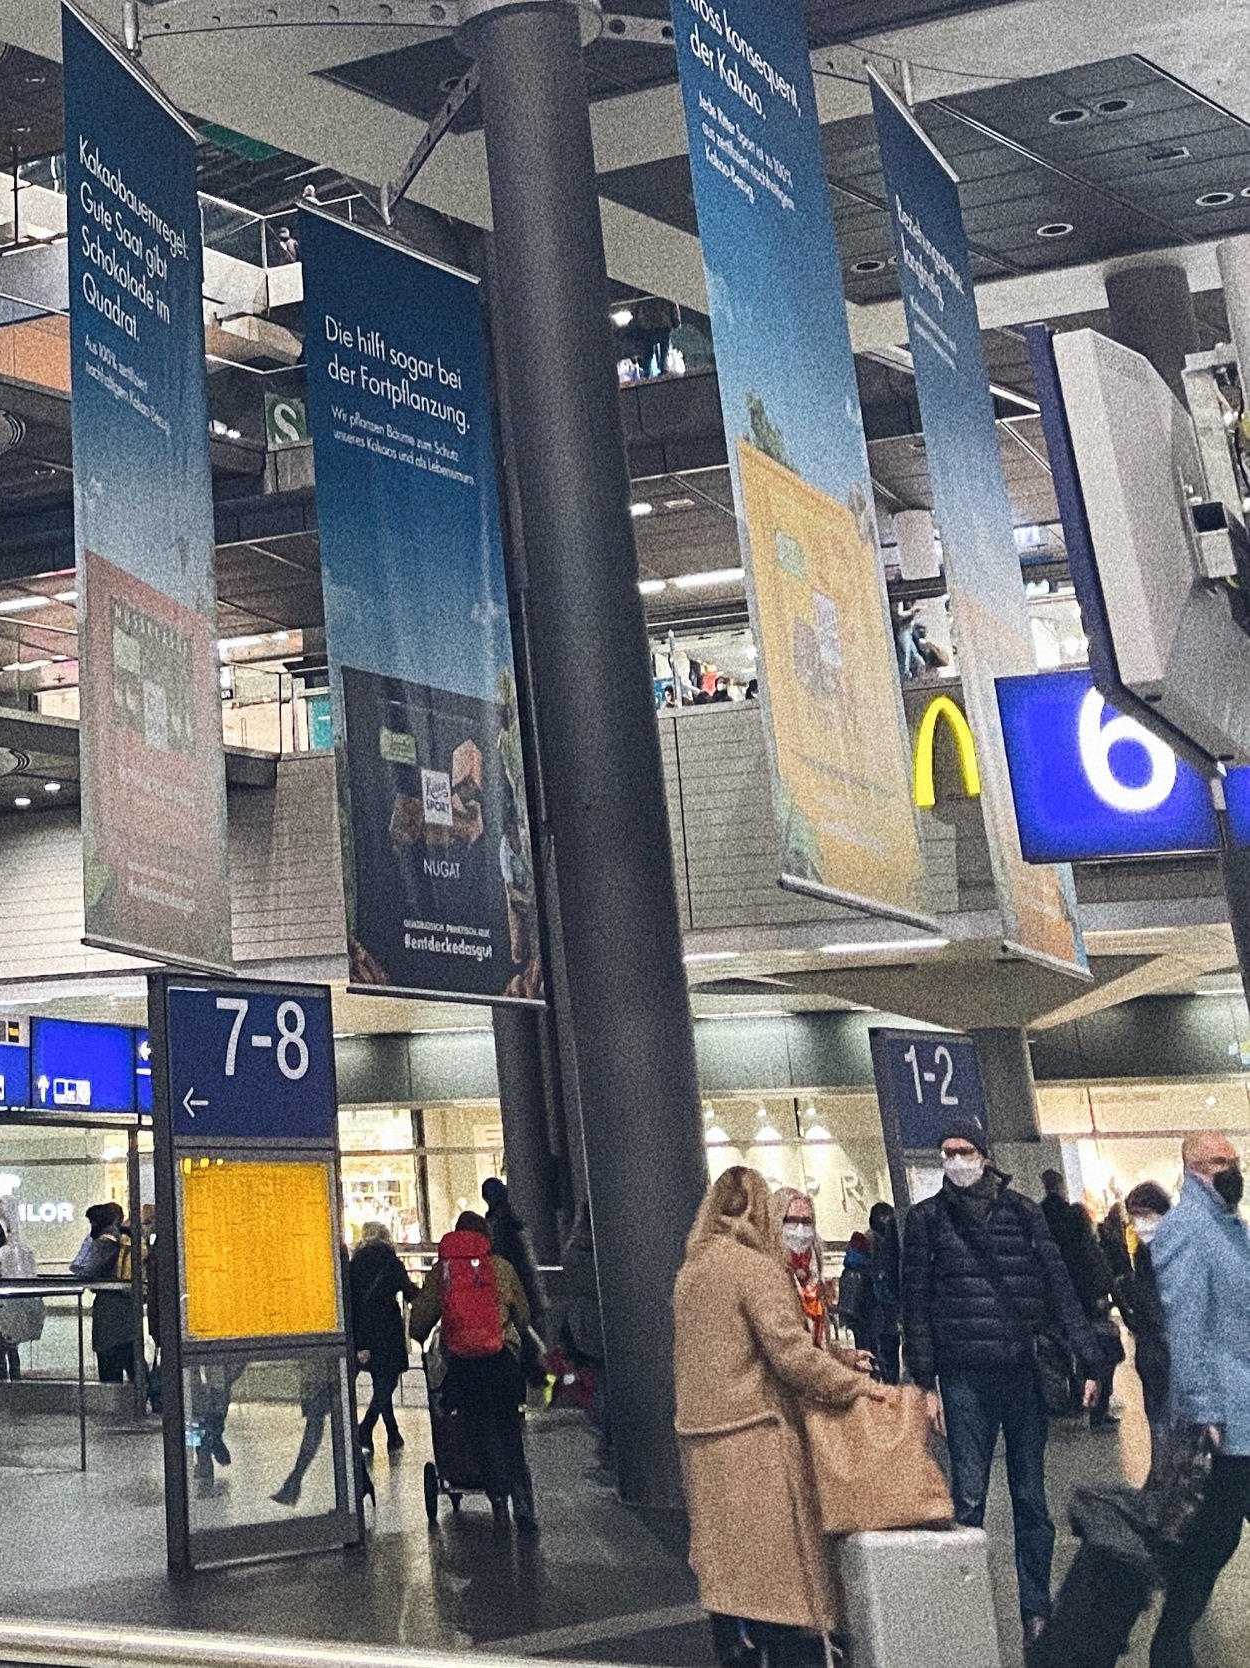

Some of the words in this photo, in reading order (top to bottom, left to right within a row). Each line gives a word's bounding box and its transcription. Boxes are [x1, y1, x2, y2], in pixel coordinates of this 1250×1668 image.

[690, 23, 714, 71] der
[717, 47, 767, 120] Kakao.
[722, 9, 802, 118] konsequent,
[79, 135, 190, 260] Kakaobauernregel:
[81, 181, 112, 232] Gute
[115, 211, 143, 260] Saat
[146, 244, 168, 281] gibt
[82, 225, 154, 310] Schokolade
[156, 289, 170, 324] im
[83, 272, 140, 342] Quadrat.
[325, 315, 354, 348] Die
[357, 325, 385, 361] hilft
[390, 348, 434, 381] sogar
[437, 357, 462, 390] bei
[328, 353, 356, 386] der
[360, 365, 470, 435] Fortpflanzung.
[331, 404, 347, 422] Wir
[349, 411, 385, 435] pflanzen
[386, 423, 415, 446] Bäume
[416, 437, 432, 452] zum
[433, 441, 459, 462] Schutz
[367, 436, 397, 460] Kakaos
[398, 450, 414, 465] und
[415, 454, 427, 470] als
[1079, 685, 1178, 812] 6
[426, 800, 450, 813] SPORT
[423, 858, 461, 878] NUGAT
[404, 933, 493, 961] #entdeckedasgut
[216, 997, 309, 1080] 7-8
[904, 1044, 959, 1106] 1-2
